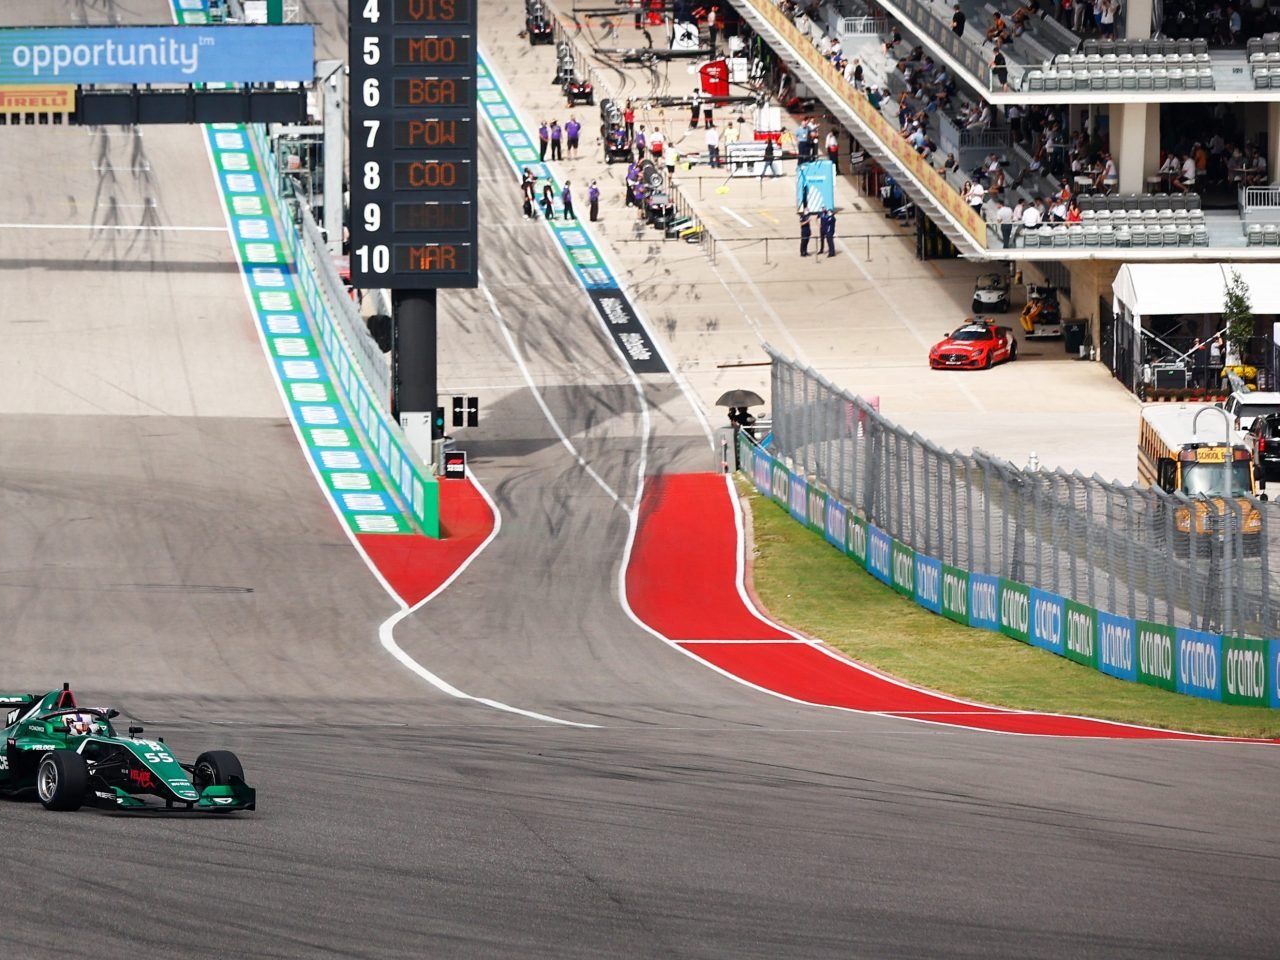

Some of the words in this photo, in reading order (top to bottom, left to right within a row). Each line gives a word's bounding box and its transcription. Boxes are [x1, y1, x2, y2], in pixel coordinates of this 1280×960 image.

[12, 37, 199, 75] opportunity
[363, 36, 381, 66] 5
[408, 38, 455, 62] MOO
[363, 78, 380, 107] 6
[408, 79, 455, 104] BGA
[363, 120, 381, 148] 7
[408, 120, 456, 145] POW
[363, 161, 381, 190] 8
[408, 162, 456, 187] COO
[363, 203, 381, 232] 9
[355, 245, 390, 274] 10
[408, 245, 456, 270] MAR
[1140, 630, 1172, 681] aramco
[1181, 639, 1217, 690] aramco
[1226, 648, 1265, 698] aramco
[144, 752, 174, 763] 55
